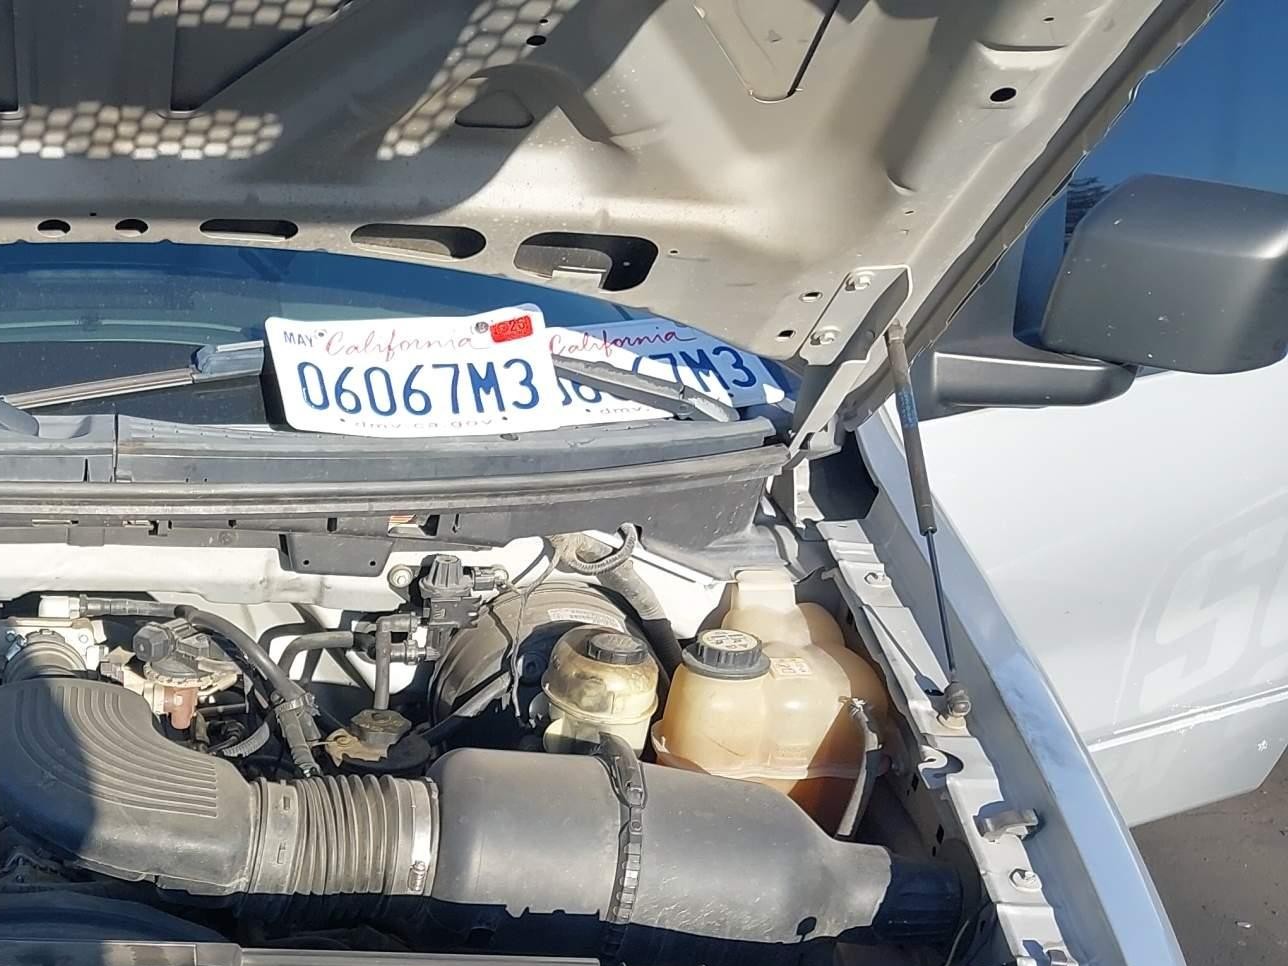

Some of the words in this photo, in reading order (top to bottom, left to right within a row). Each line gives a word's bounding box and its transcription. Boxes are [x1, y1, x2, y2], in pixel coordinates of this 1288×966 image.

[283, 331, 313, 348] MAY
[325, 329, 489, 362] California
[549, 329, 697, 358] California
[297, 358, 540, 417] 06067M3
